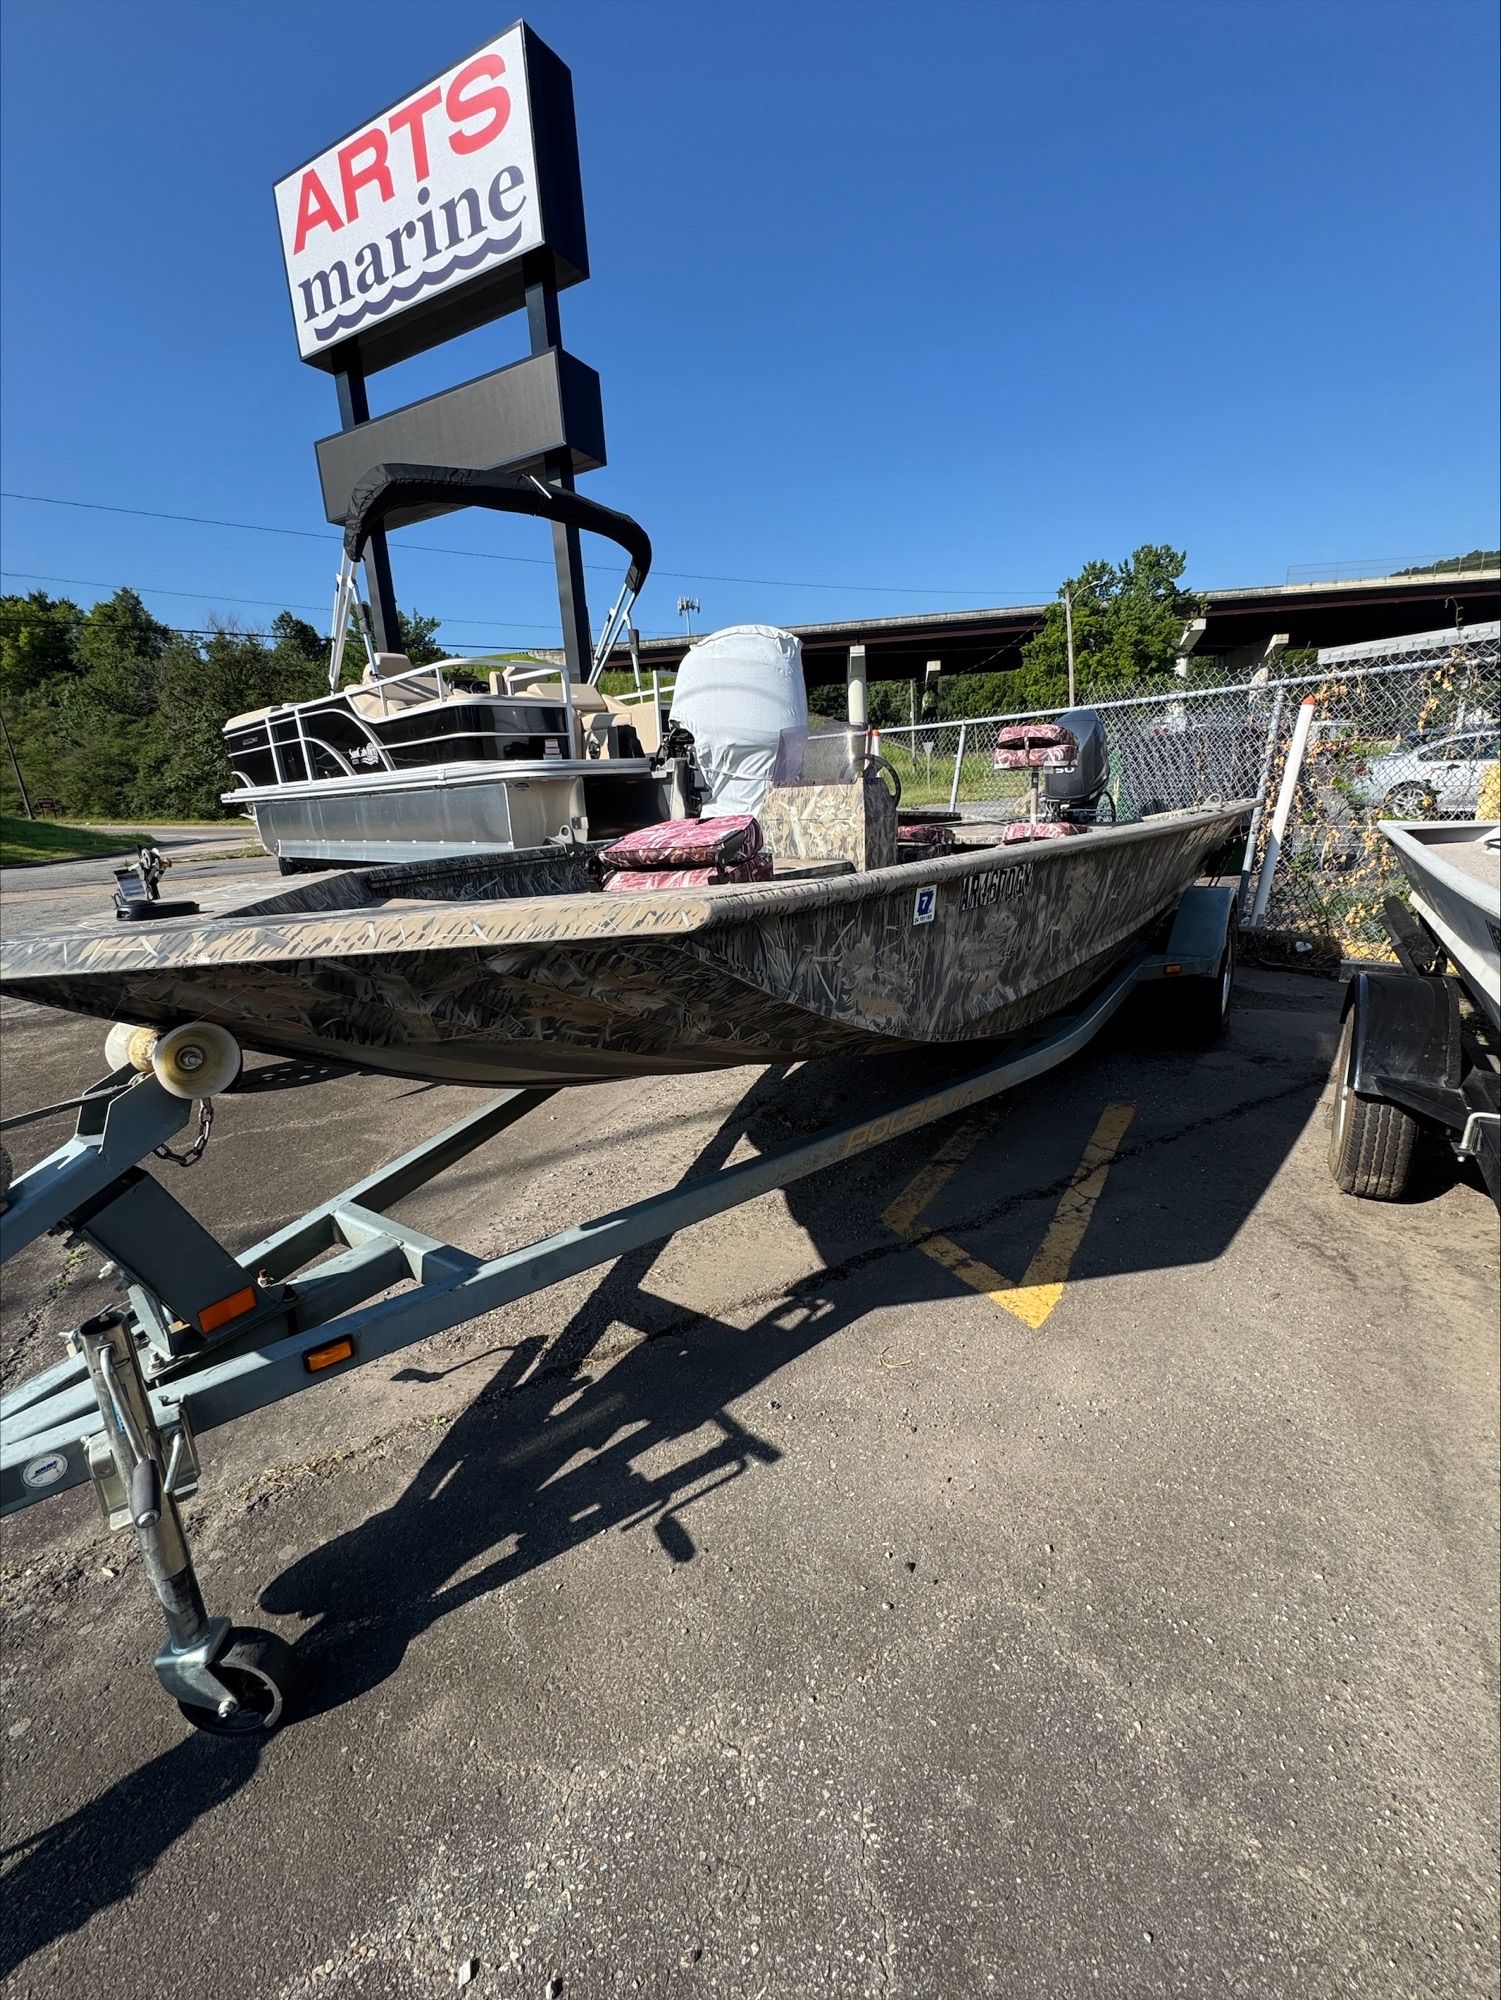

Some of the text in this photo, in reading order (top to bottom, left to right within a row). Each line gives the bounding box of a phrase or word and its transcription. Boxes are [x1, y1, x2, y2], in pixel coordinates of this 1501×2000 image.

[293, 54, 511, 256] ARTS
[298, 164, 527, 324] marine
[921, 896, 929, 910] 7
